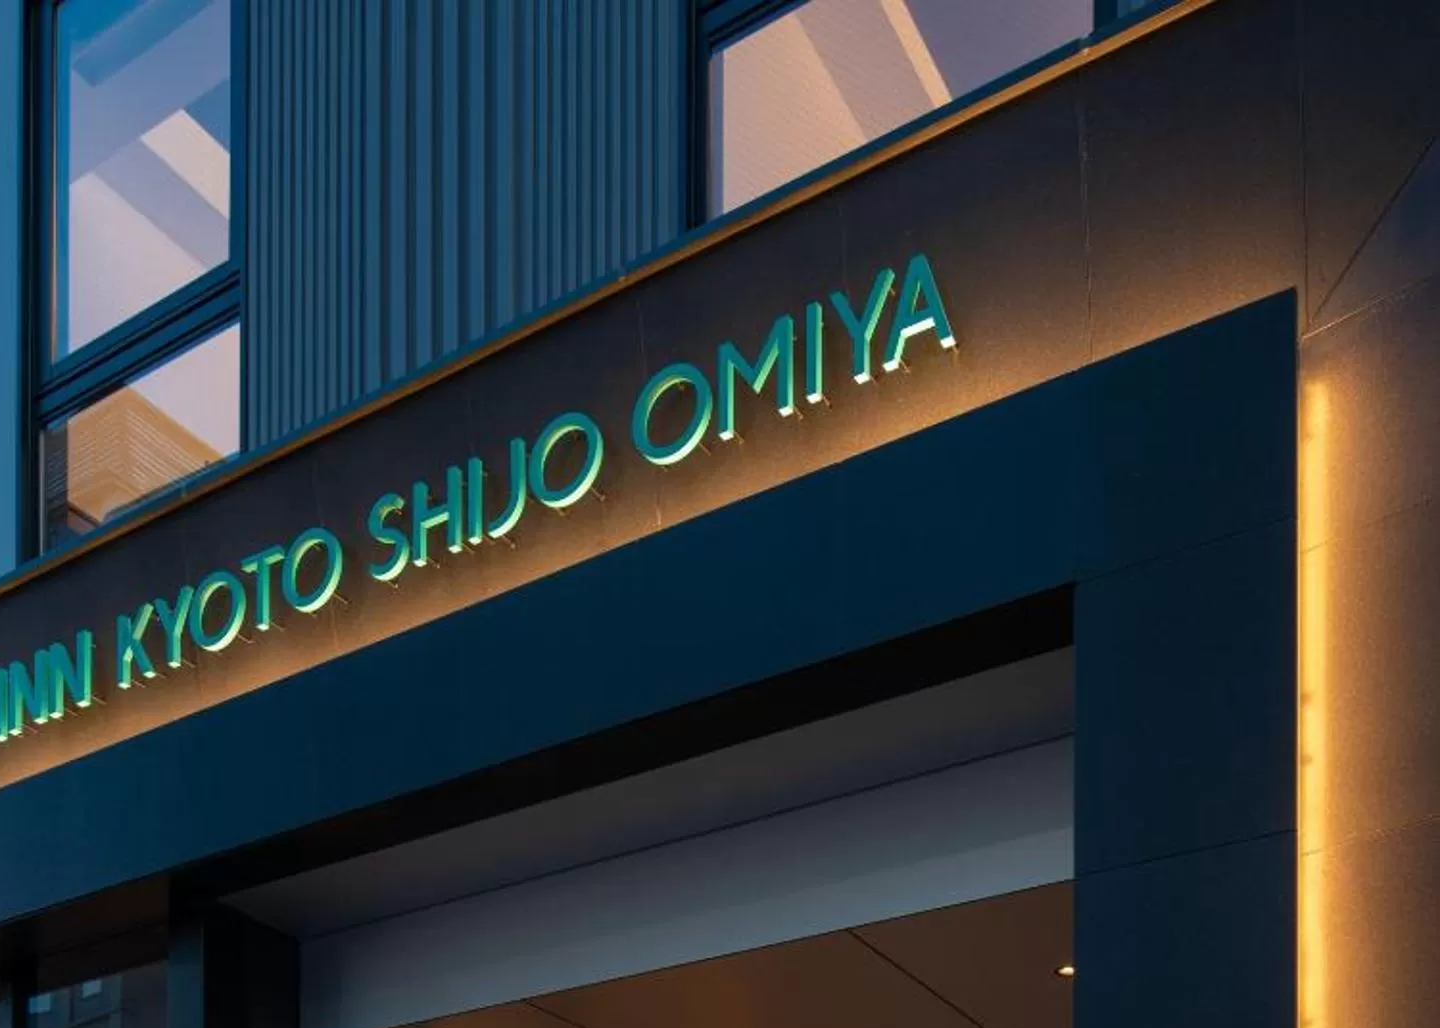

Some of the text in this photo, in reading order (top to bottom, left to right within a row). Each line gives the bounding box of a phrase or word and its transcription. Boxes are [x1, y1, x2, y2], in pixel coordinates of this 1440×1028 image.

[115, 527, 344, 690] KYOTO
[367, 411, 605, 583] SHIJO
[631, 253, 956, 466] OMIYA
